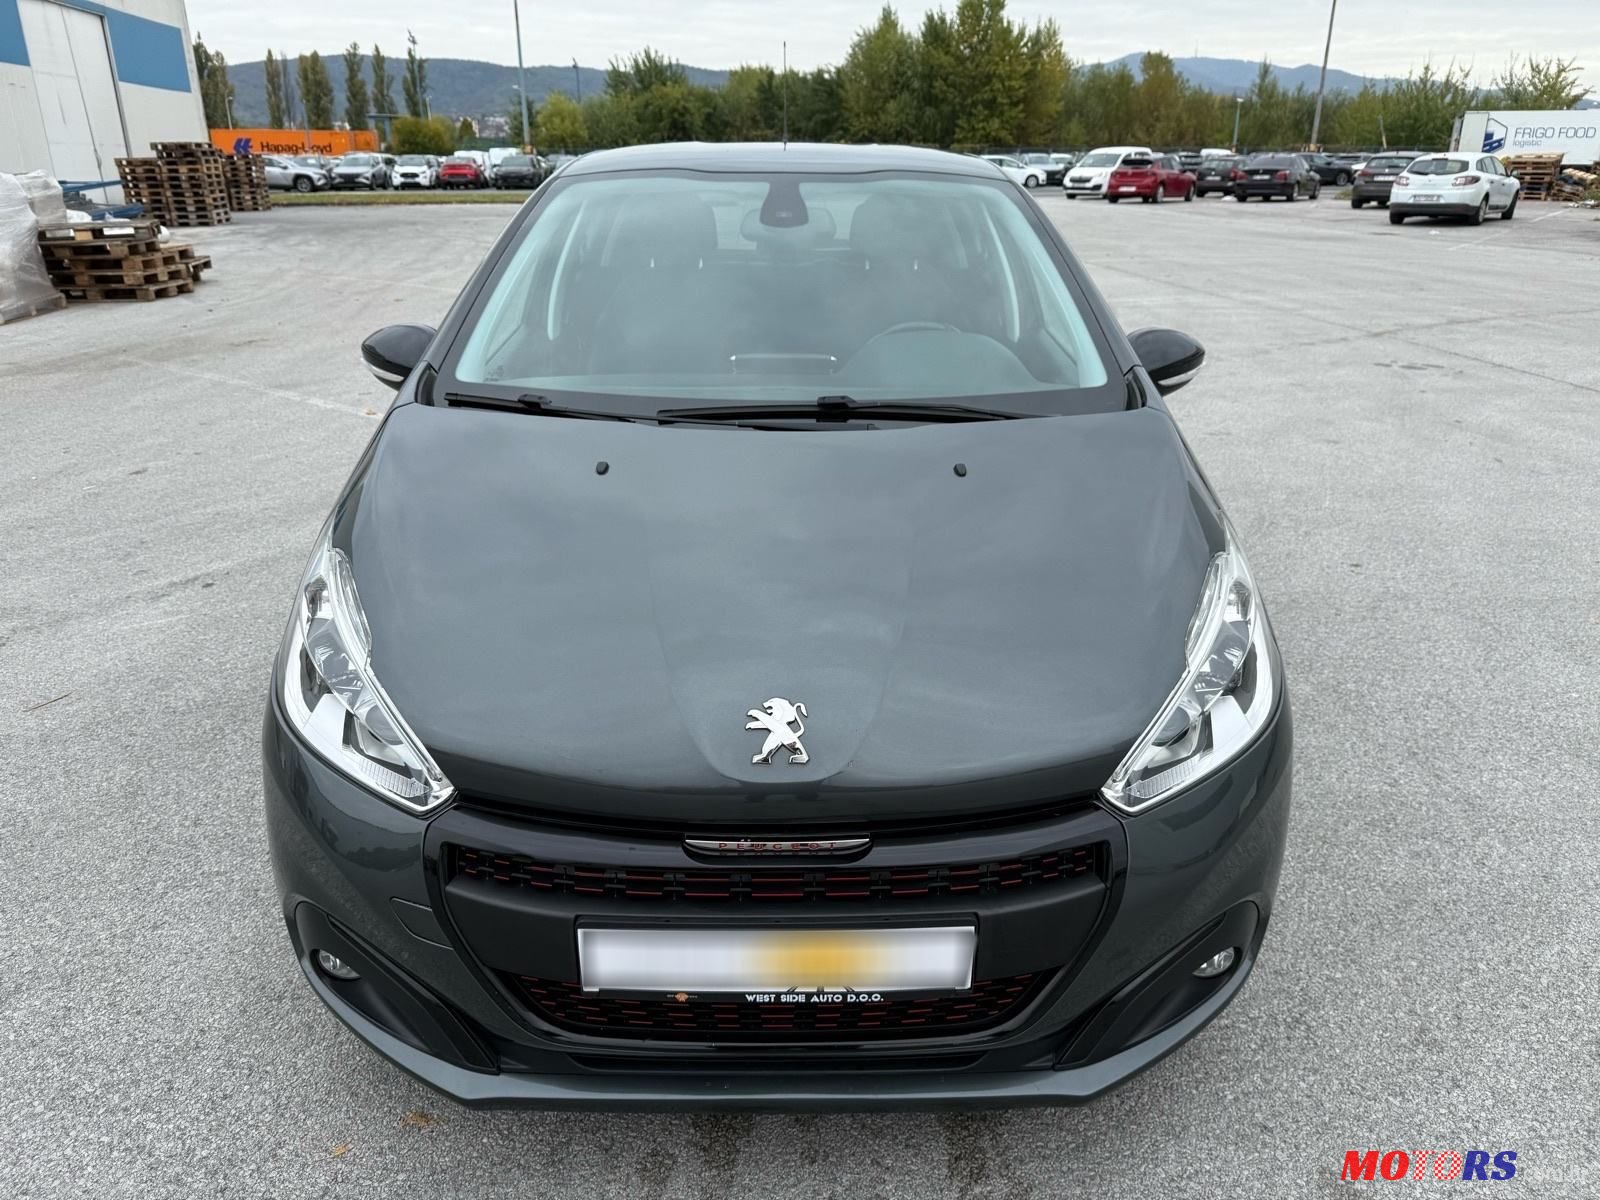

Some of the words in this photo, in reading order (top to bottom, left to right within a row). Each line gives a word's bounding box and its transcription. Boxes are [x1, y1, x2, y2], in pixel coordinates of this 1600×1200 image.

[1514, 126, 1556, 139] FRIGO
[1558, 126, 1597, 139] FOOD
[260, 141, 333, 154] Hapag-Loyd
[718, 841, 837, 850] PEUGEOT
[745, 993, 776, 1003] WEST
[780, 993, 806, 1003] SIDE
[810, 993, 843, 1003] AUTO
[847, 993, 884, 1002] D.O.O.
